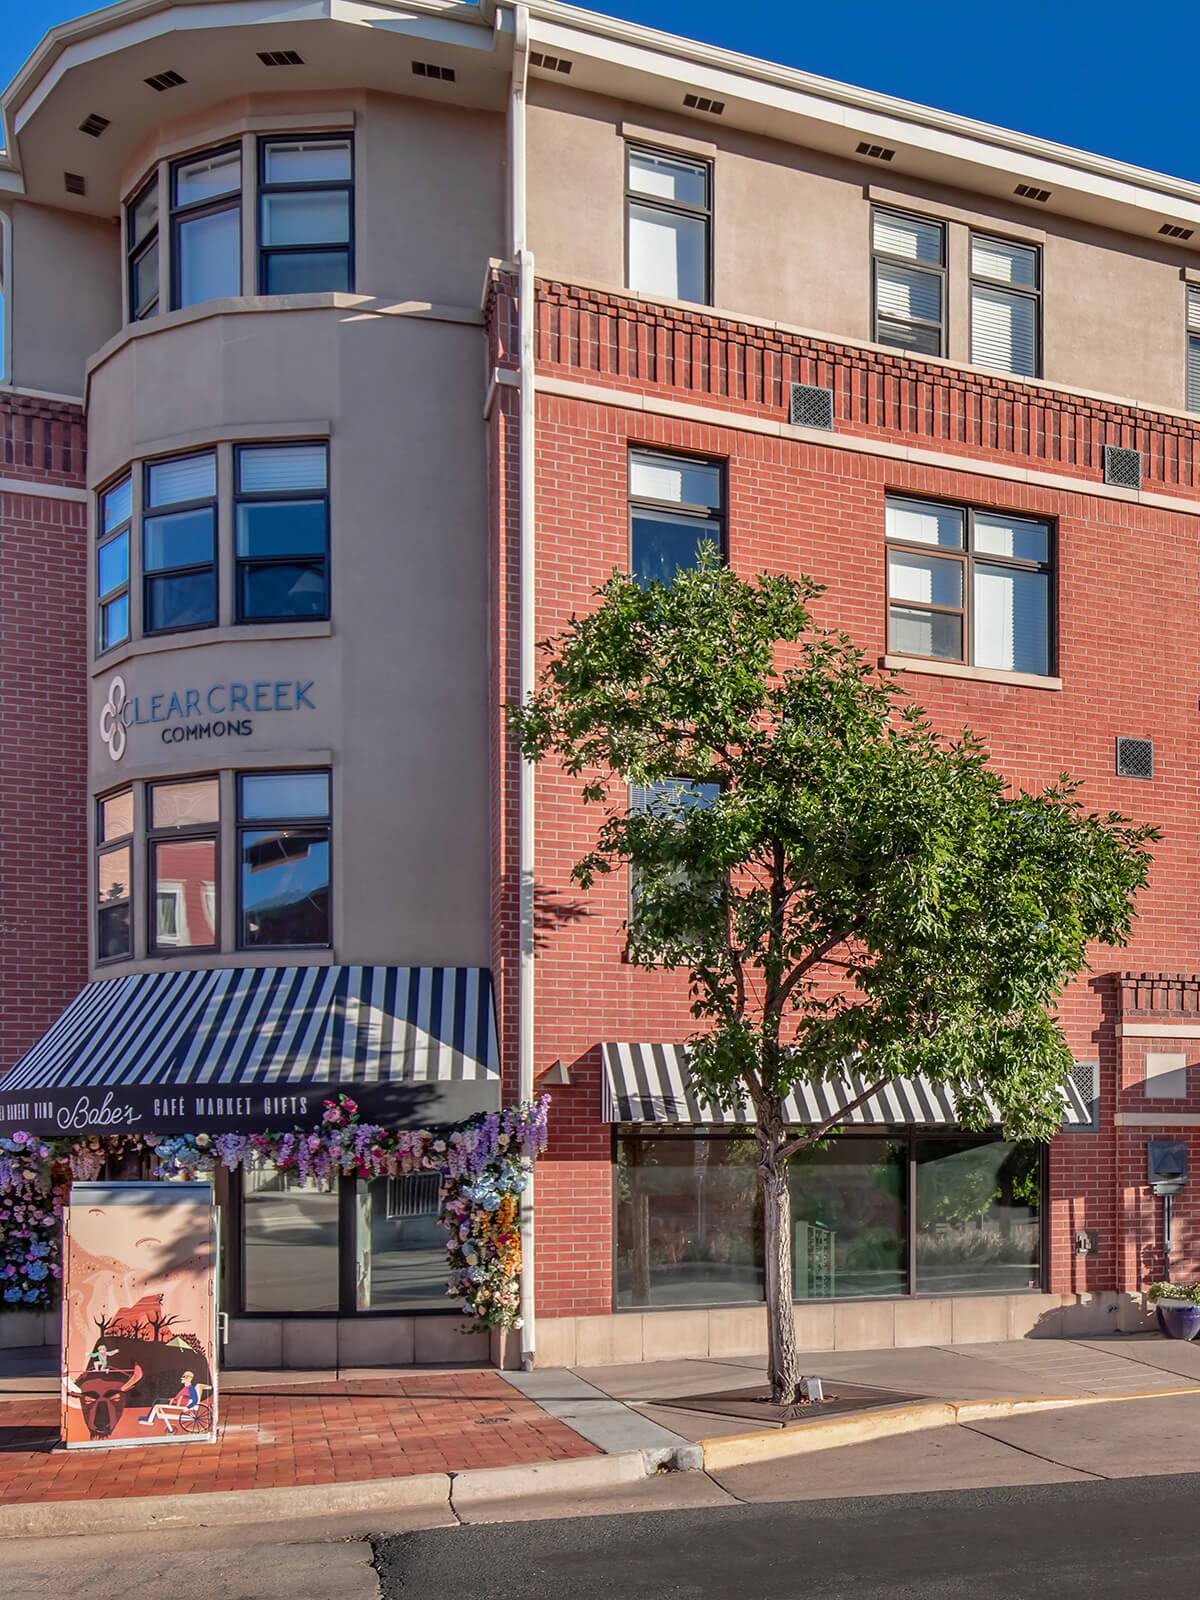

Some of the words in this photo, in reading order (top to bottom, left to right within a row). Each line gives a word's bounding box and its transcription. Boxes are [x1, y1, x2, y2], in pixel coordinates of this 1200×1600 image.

[161, 719, 253, 744] COMMONS
[57, 1091, 142, 1129] Babe's
[153, 1096, 185, 1117] CAFÉ
[195, 1097, 251, 1116] MARKET
[263, 1096, 308, 1116] GIFTS
